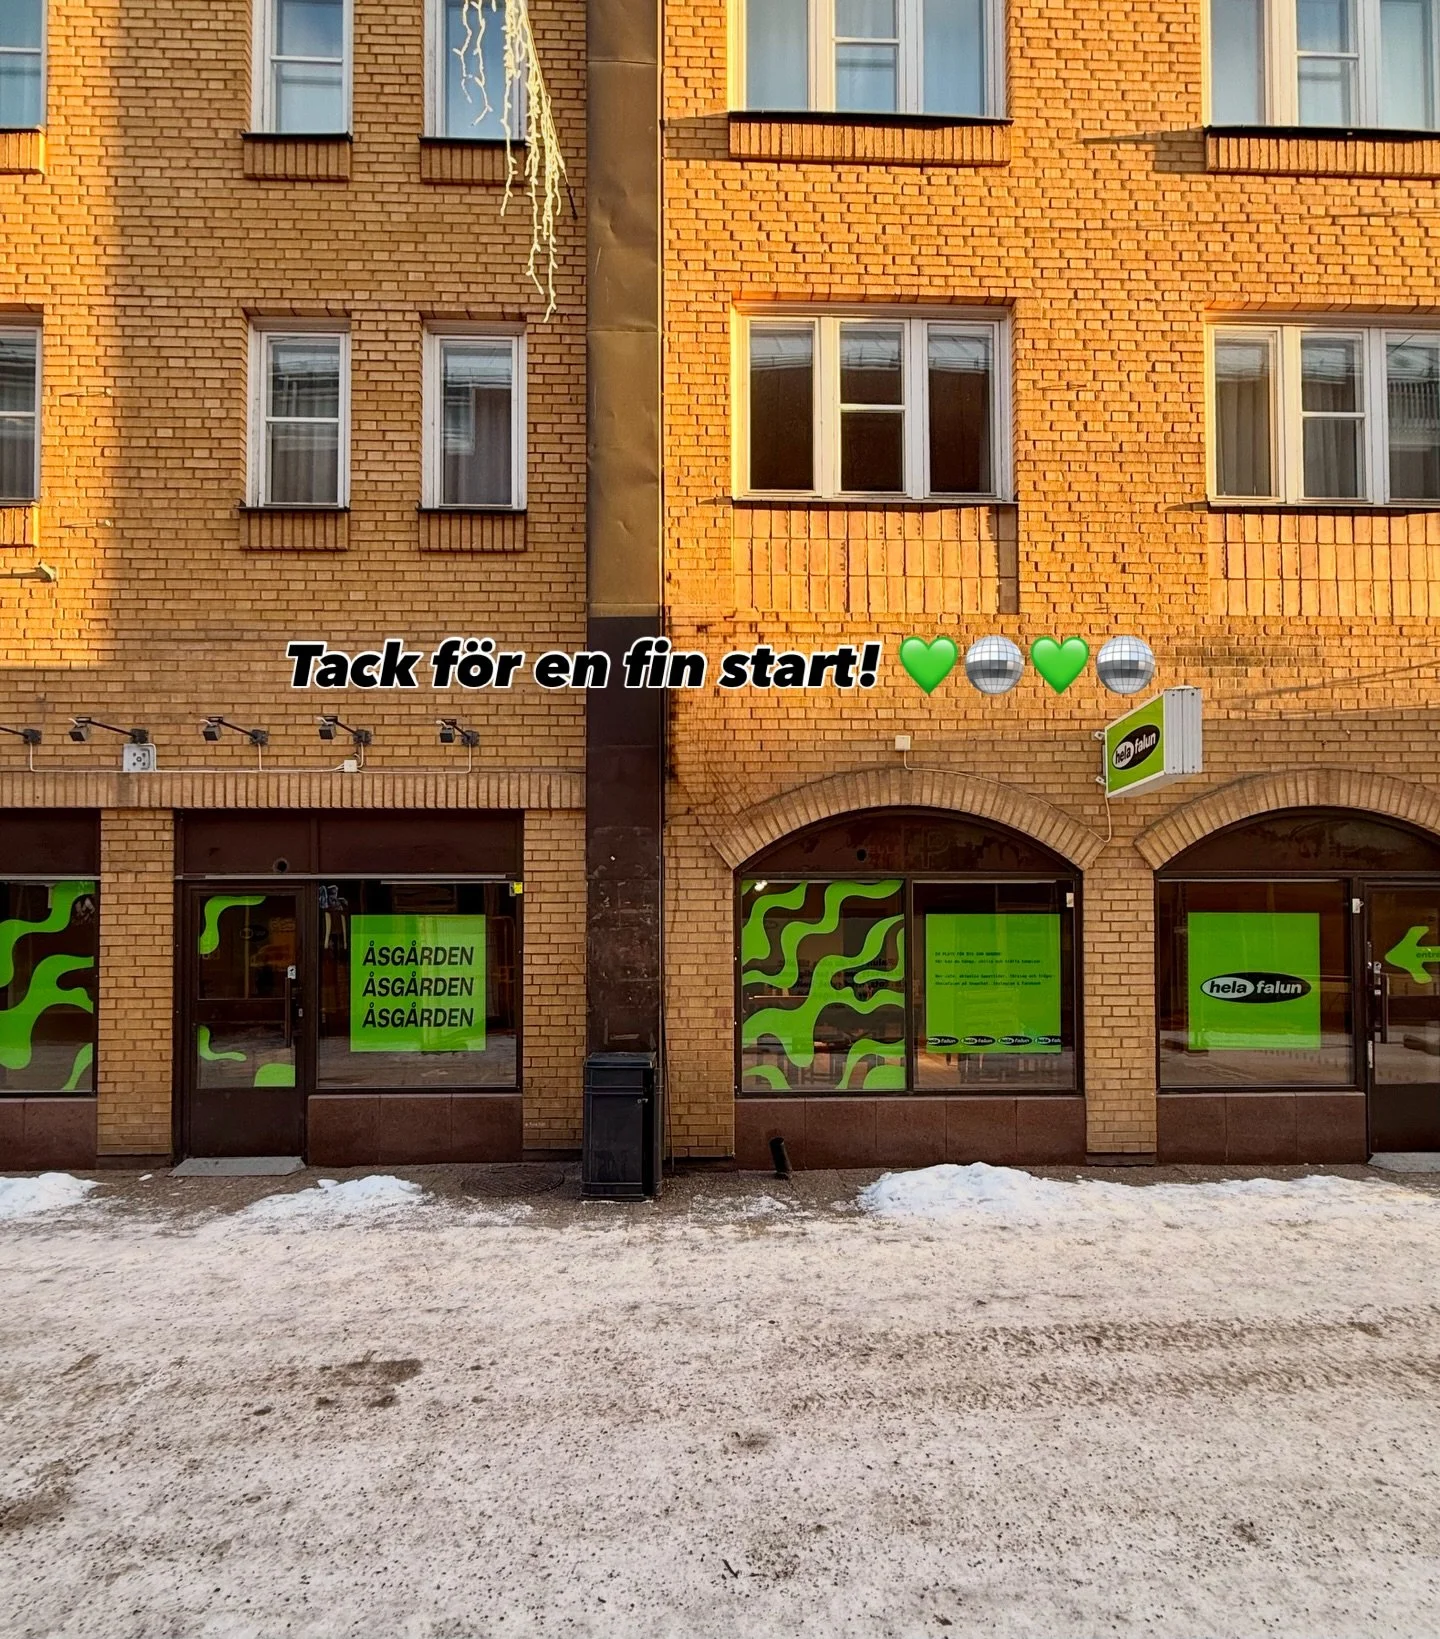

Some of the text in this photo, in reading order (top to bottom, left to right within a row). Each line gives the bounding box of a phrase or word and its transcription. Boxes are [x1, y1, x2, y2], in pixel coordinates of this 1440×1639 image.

[1115, 732, 1156, 764] hela falun
[362, 940, 474, 966] ÅSGÅRDEN
[362, 971, 474, 997] ÅSGÅRDEN
[1209, 980, 1302, 994] hela falun
[362, 1002, 474, 1028] ÅSGÅRDEN
